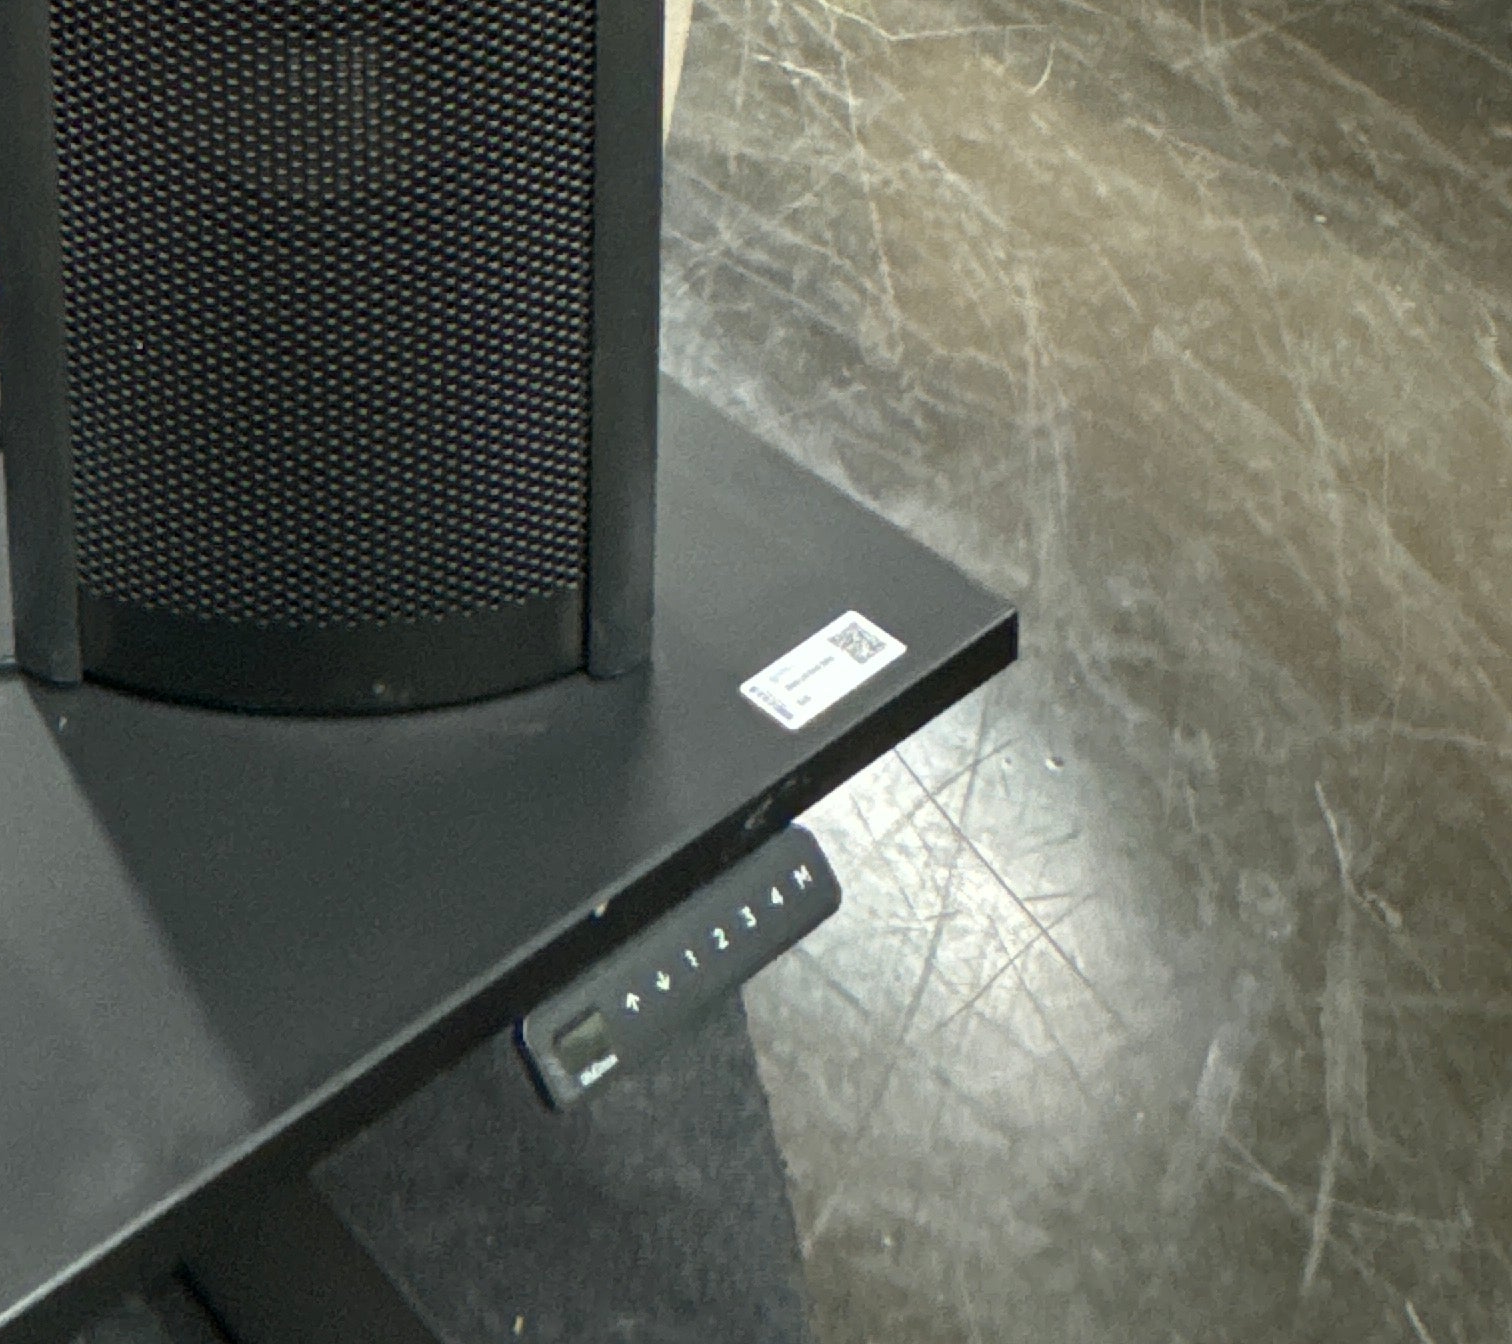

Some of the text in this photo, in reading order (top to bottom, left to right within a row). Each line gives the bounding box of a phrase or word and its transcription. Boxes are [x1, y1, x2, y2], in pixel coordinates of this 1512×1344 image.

[712, 927, 730, 950] 2
[740, 905, 757, 928] 3
[770, 886, 784, 905] 4
